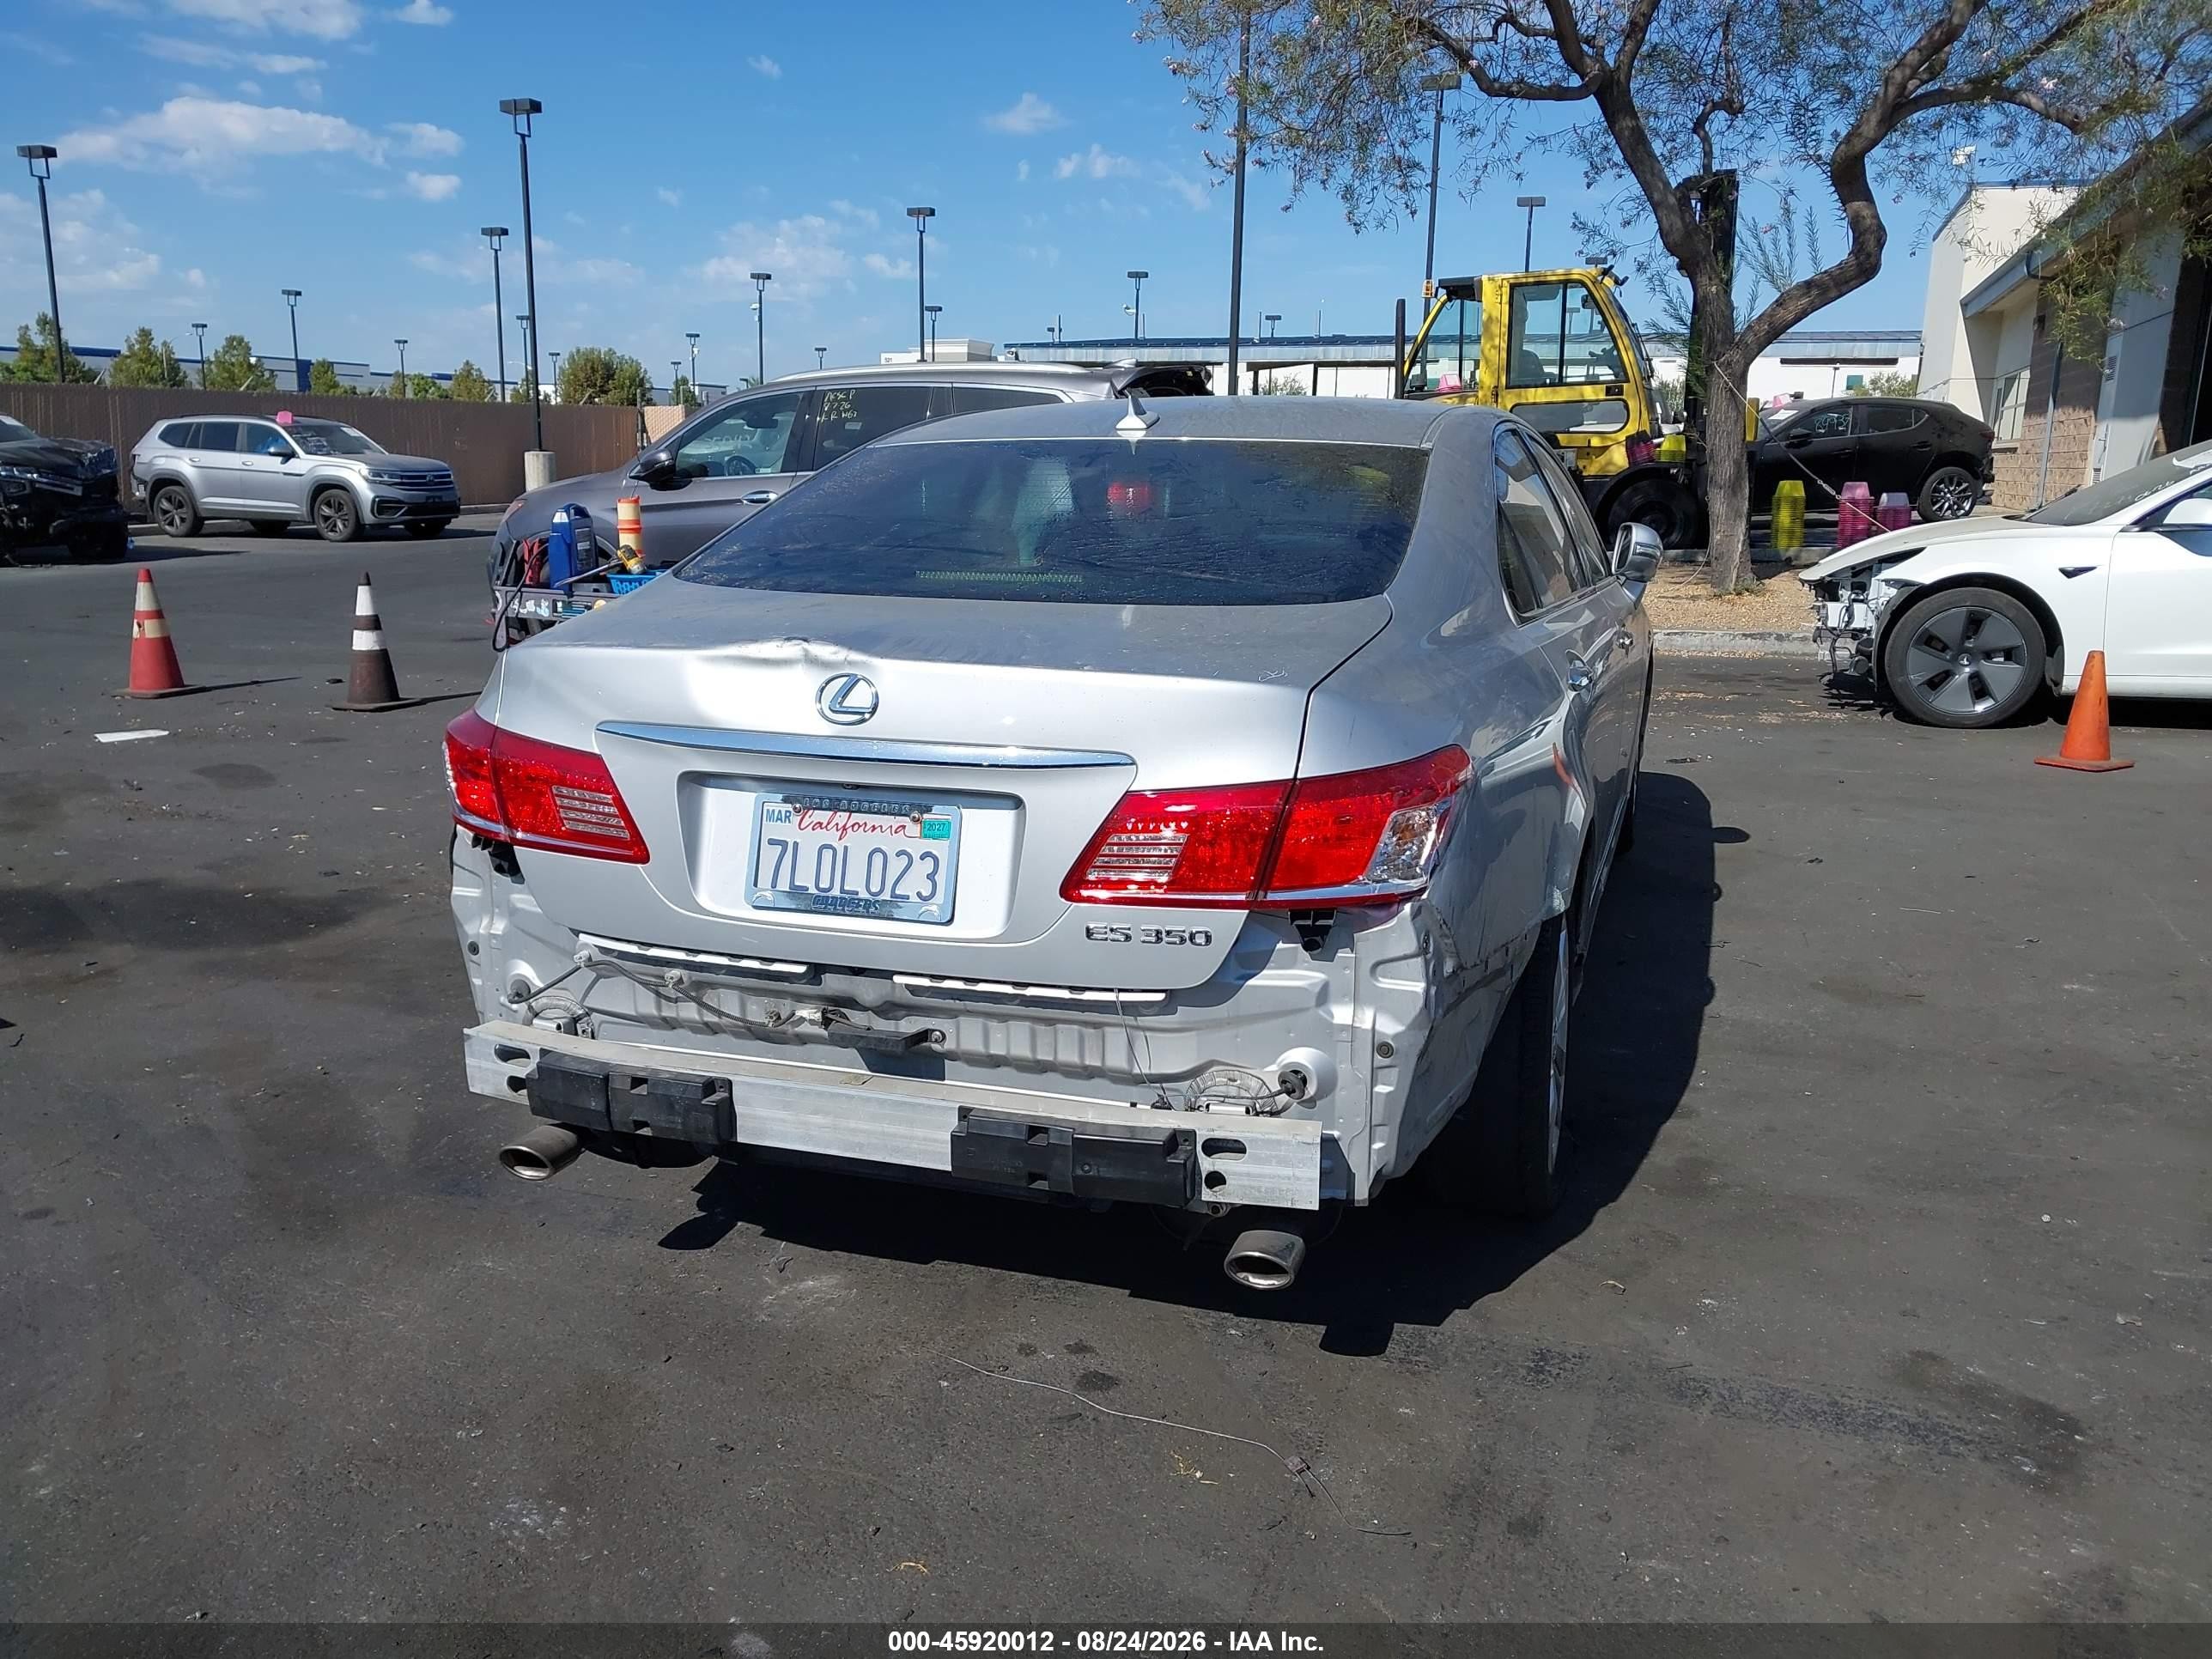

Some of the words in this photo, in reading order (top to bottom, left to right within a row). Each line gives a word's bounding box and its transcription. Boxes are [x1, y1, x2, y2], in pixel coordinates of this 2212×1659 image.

[765, 808, 792, 824] MAR
[797, 809, 921, 842] California
[927, 823, 947, 832] 2027
[767, 837, 940, 902] 7LOL023
[1085, 922, 1133, 943] ES
[1139, 924, 1212, 947] 350
